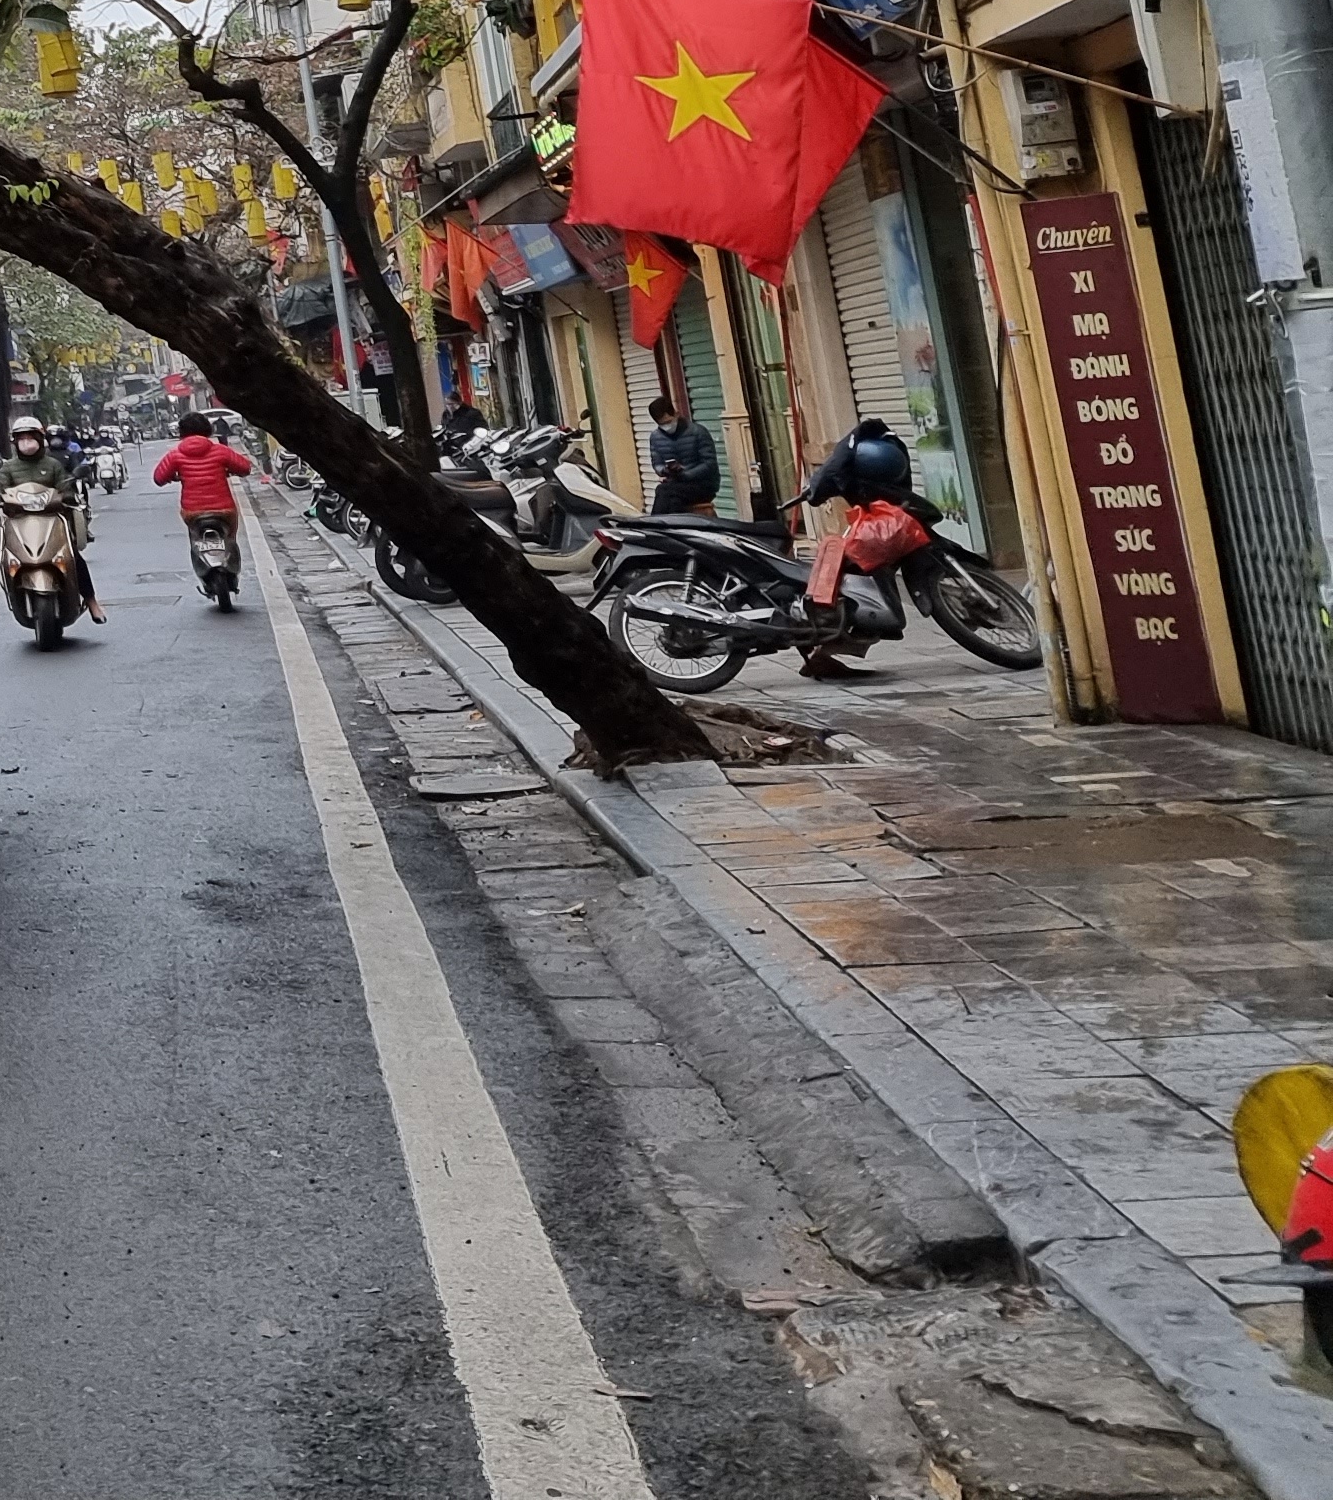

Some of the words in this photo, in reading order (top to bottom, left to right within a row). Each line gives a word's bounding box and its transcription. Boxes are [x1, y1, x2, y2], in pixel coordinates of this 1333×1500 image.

[1036, 220, 1112, 251] Chuyên
[1070, 270, 1096, 294] XI
[1072, 312, 1110, 340] MẠ
[1070, 352, 1131, 380] ĐÁNH
[1076, 395, 1140, 423] BÓNG
[1089, 484, 1163, 509] TRANG
[1113, 568, 1177, 596] VÀNG
[1135, 617, 1179, 646] BẠC
